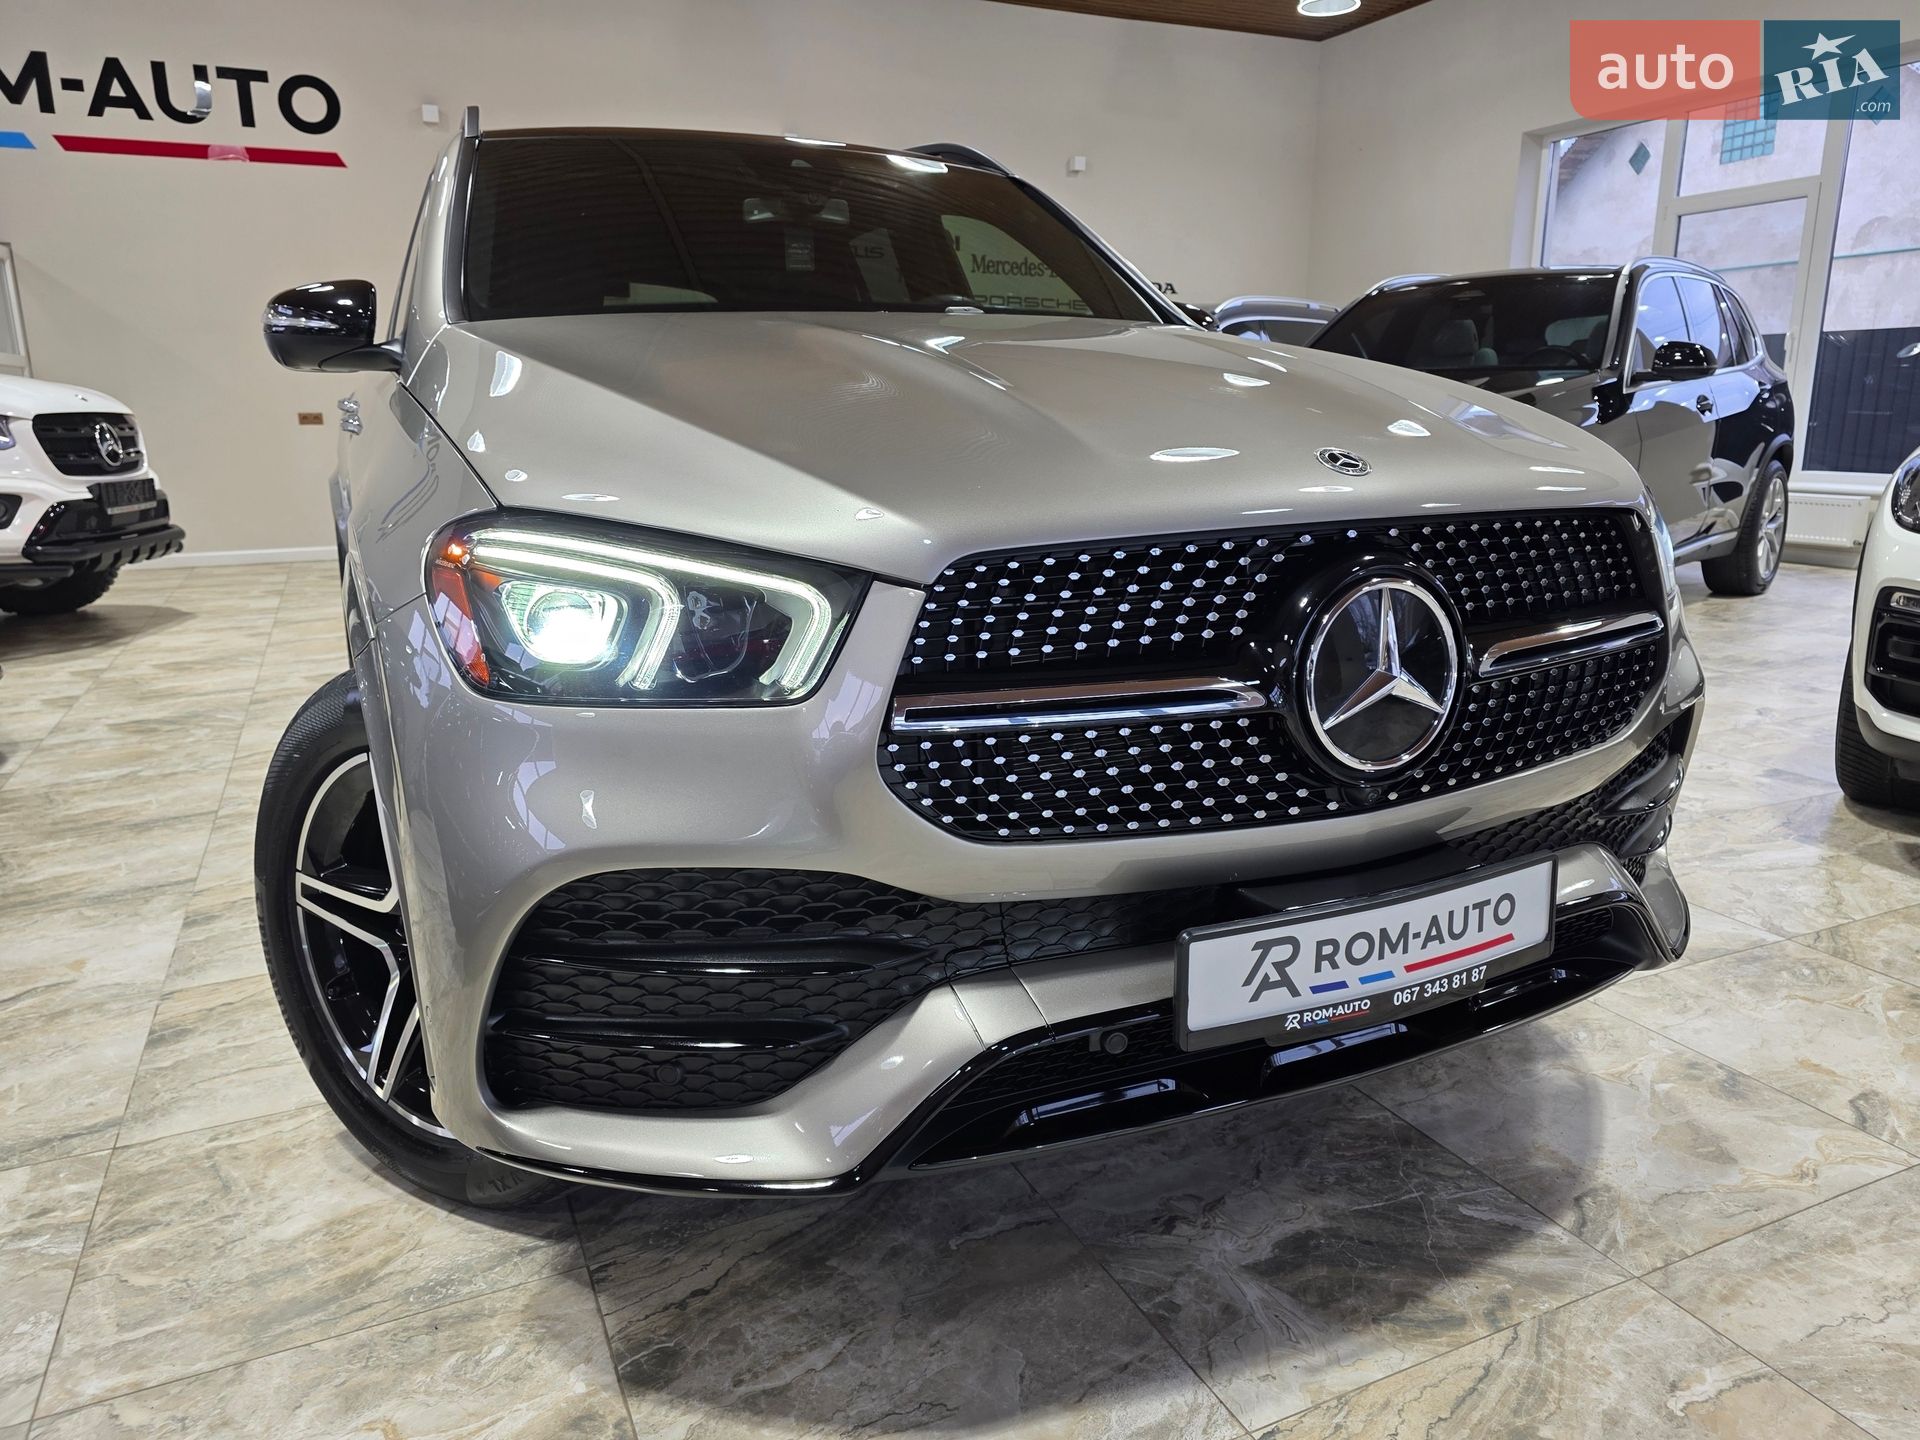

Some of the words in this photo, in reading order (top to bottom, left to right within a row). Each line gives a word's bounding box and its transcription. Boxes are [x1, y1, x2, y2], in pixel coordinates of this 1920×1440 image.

[1314, 893, 1516, 974] ROM-AUTO
[1393, 985, 1418, 1006] 067
[1424, 977, 1449, 998] 343
[1452, 972, 1468, 990] 81
[1471, 965, 1487, 984] 87
[1303, 999, 1371, 1023] ROM-AUTO
